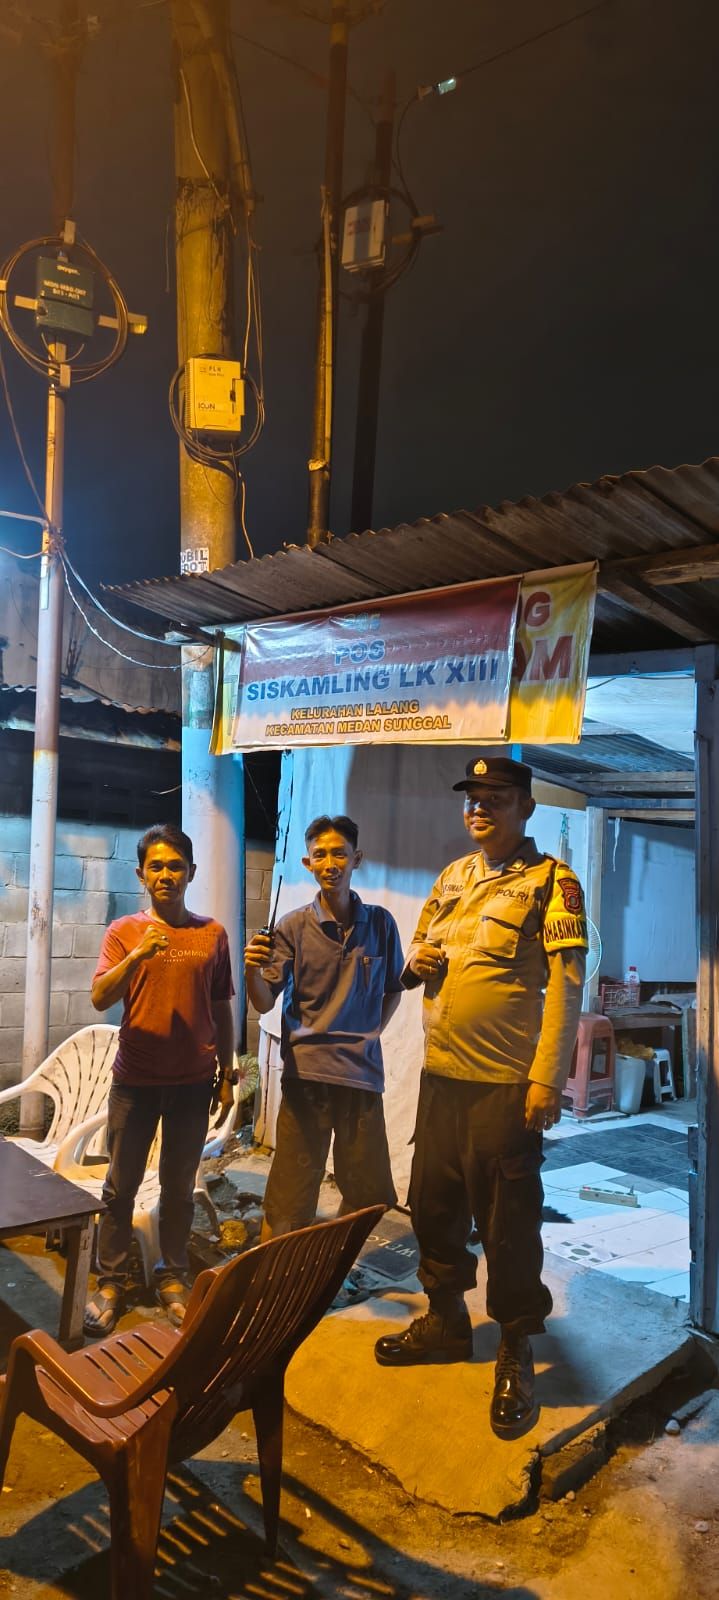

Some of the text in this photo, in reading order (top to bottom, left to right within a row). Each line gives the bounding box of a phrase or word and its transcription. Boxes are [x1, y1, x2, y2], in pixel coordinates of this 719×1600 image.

[335, 639, 385, 665] POS
[247, 656, 499, 701] SISKAMLING LK XIII
[291, 700, 419, 720] KELURAHAN LALANG
[265, 716, 452, 737] KECAMATAN MEDAN SUNGGAL
[495, 888, 530, 902] POLRI
[366, 1235, 416, 1257] WELC
